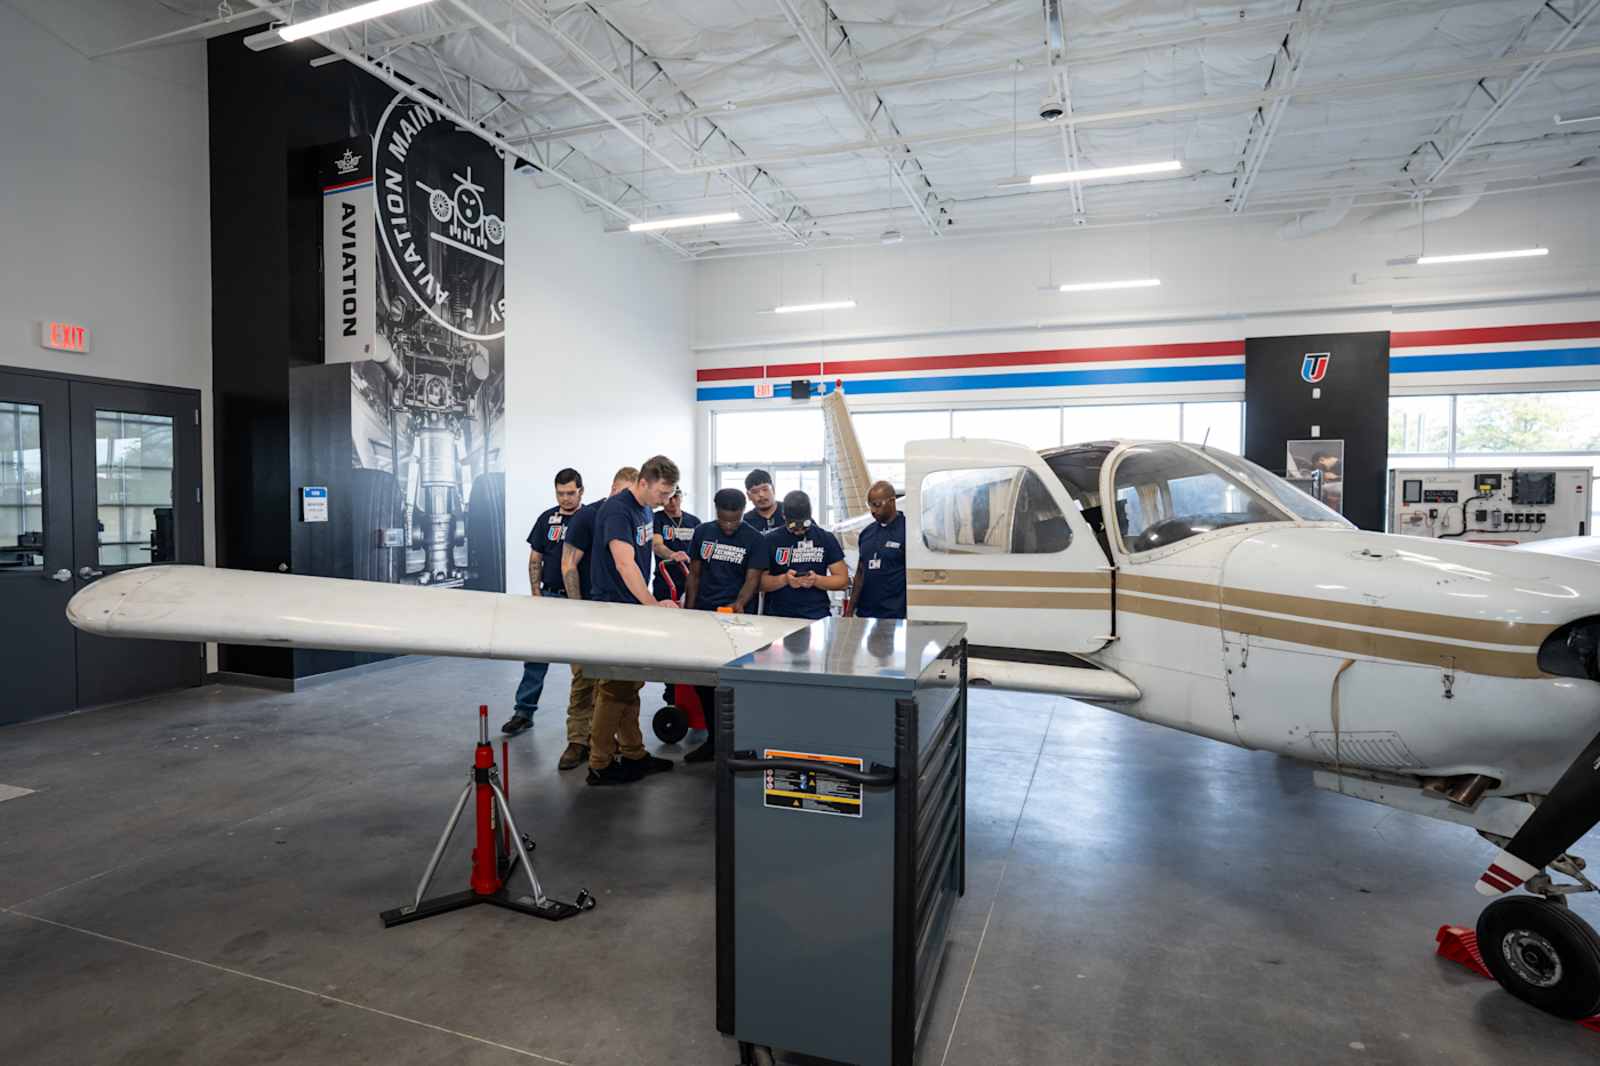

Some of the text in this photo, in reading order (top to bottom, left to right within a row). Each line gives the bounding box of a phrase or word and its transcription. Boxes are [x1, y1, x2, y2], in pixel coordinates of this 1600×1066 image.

[342, 202, 357, 337] AVIATION
[385, 104, 450, 304] AVIATION MAIN
[50, 322, 85, 349] EXIT
